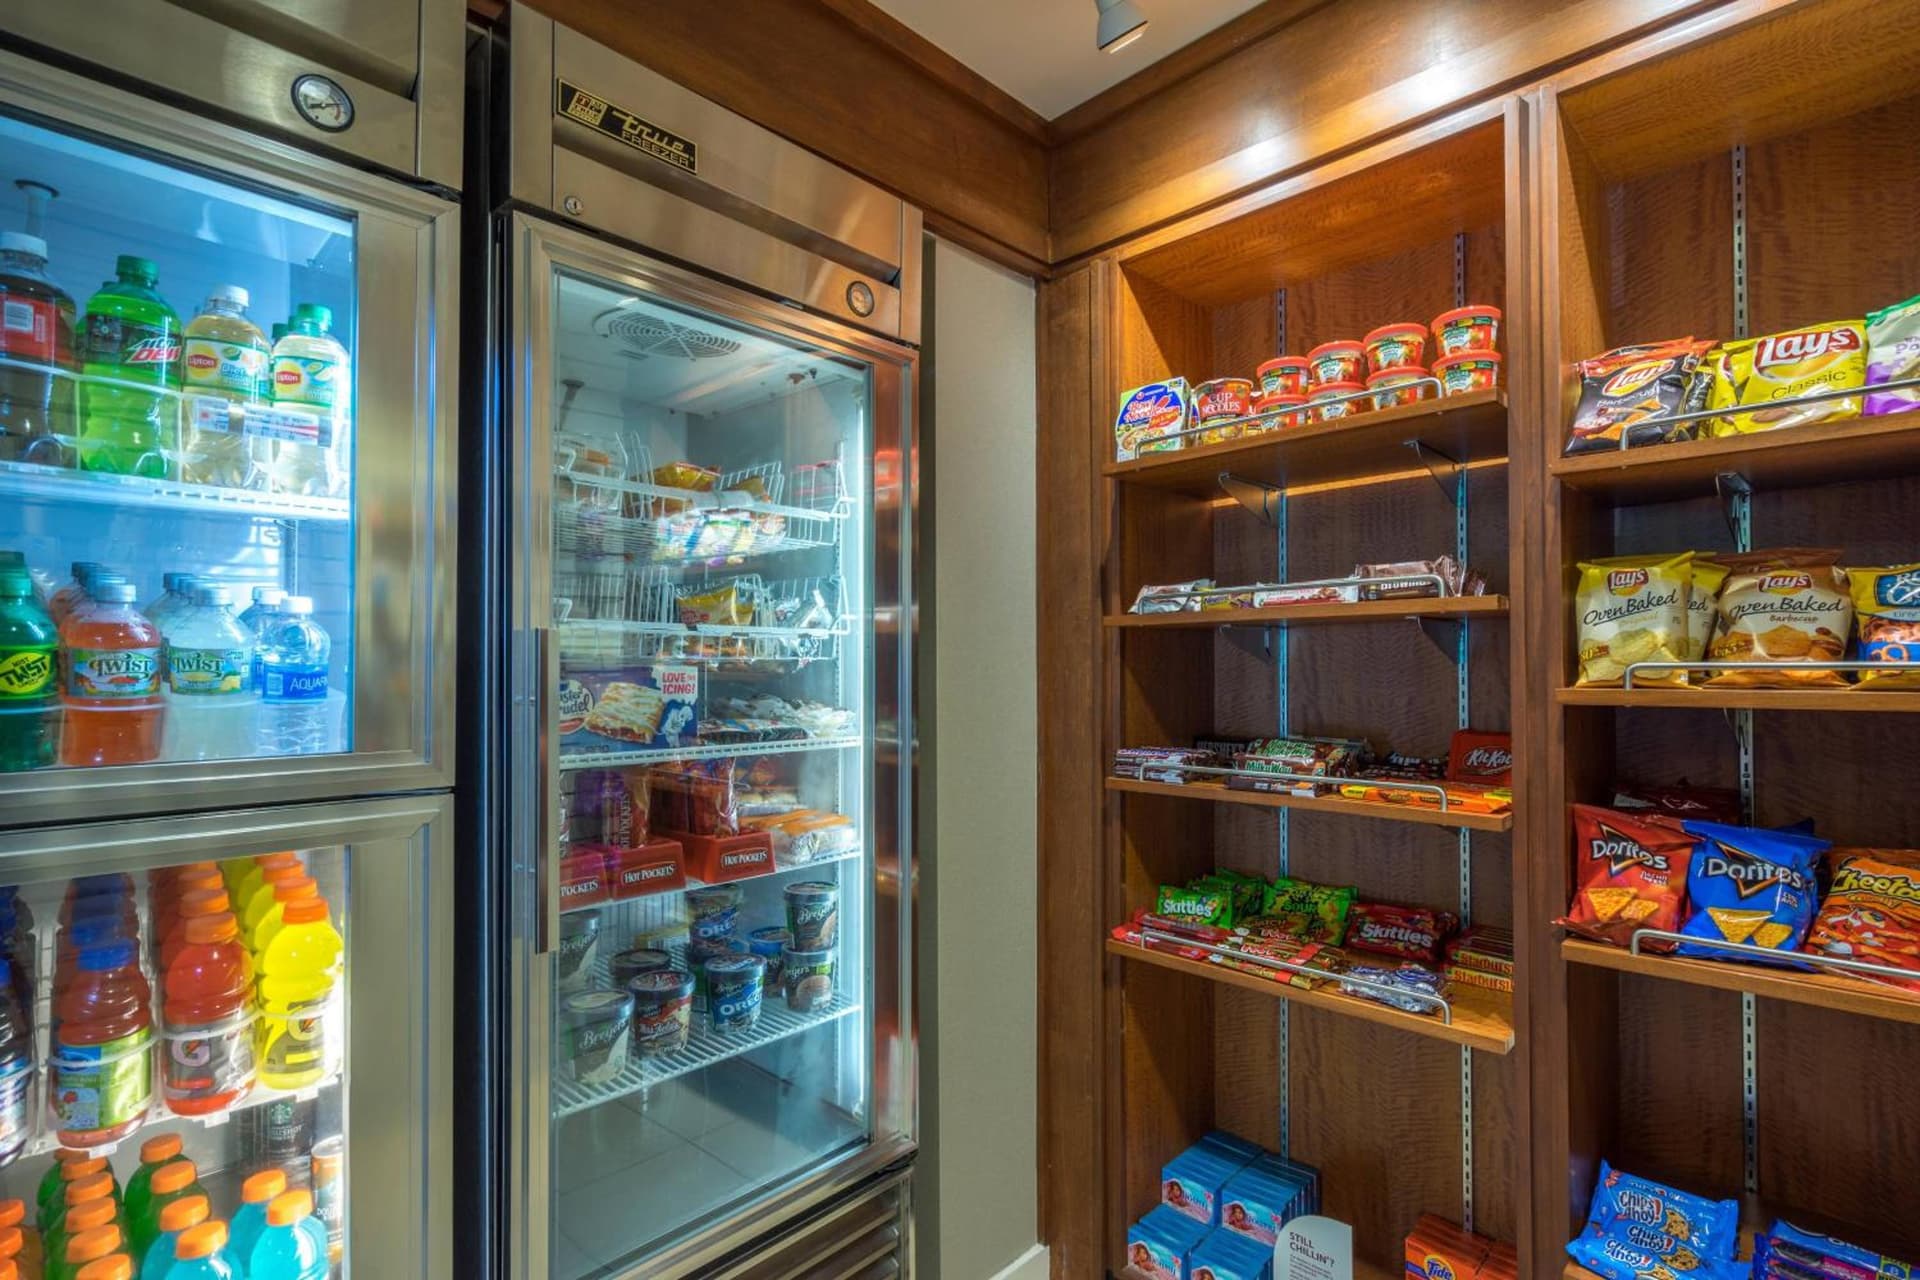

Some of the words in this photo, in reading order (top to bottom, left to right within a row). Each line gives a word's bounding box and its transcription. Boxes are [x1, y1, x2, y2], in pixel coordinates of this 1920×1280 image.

[621, 130, 689, 168] FREEZER
[1583, 606, 1626, 627] Oven
[1627, 588, 1680, 614] Baked
[1780, 595, 1845, 612] Baked
[662, 672, 687, 683] LOVE
[662, 683, 696, 695] ICING!
[724, 855, 738, 866] HOT
[738, 850, 768, 865] POCKETS
[1591, 839, 1669, 870] Doritos
[624, 871, 641, 885] HOT
[641, 863, 675, 882] POCKETS
[1707, 858, 1803, 889] Doritos
[560, 879, 598, 898] POCKETS
[1163, 899, 1213, 918] Skittles
[1360, 923, 1433, 949] Skittles
[1620, 1190, 1655, 1210] Chips
[1289, 1231, 1314, 1249] STILL
[1427, 1258, 1453, 1280] Tide
